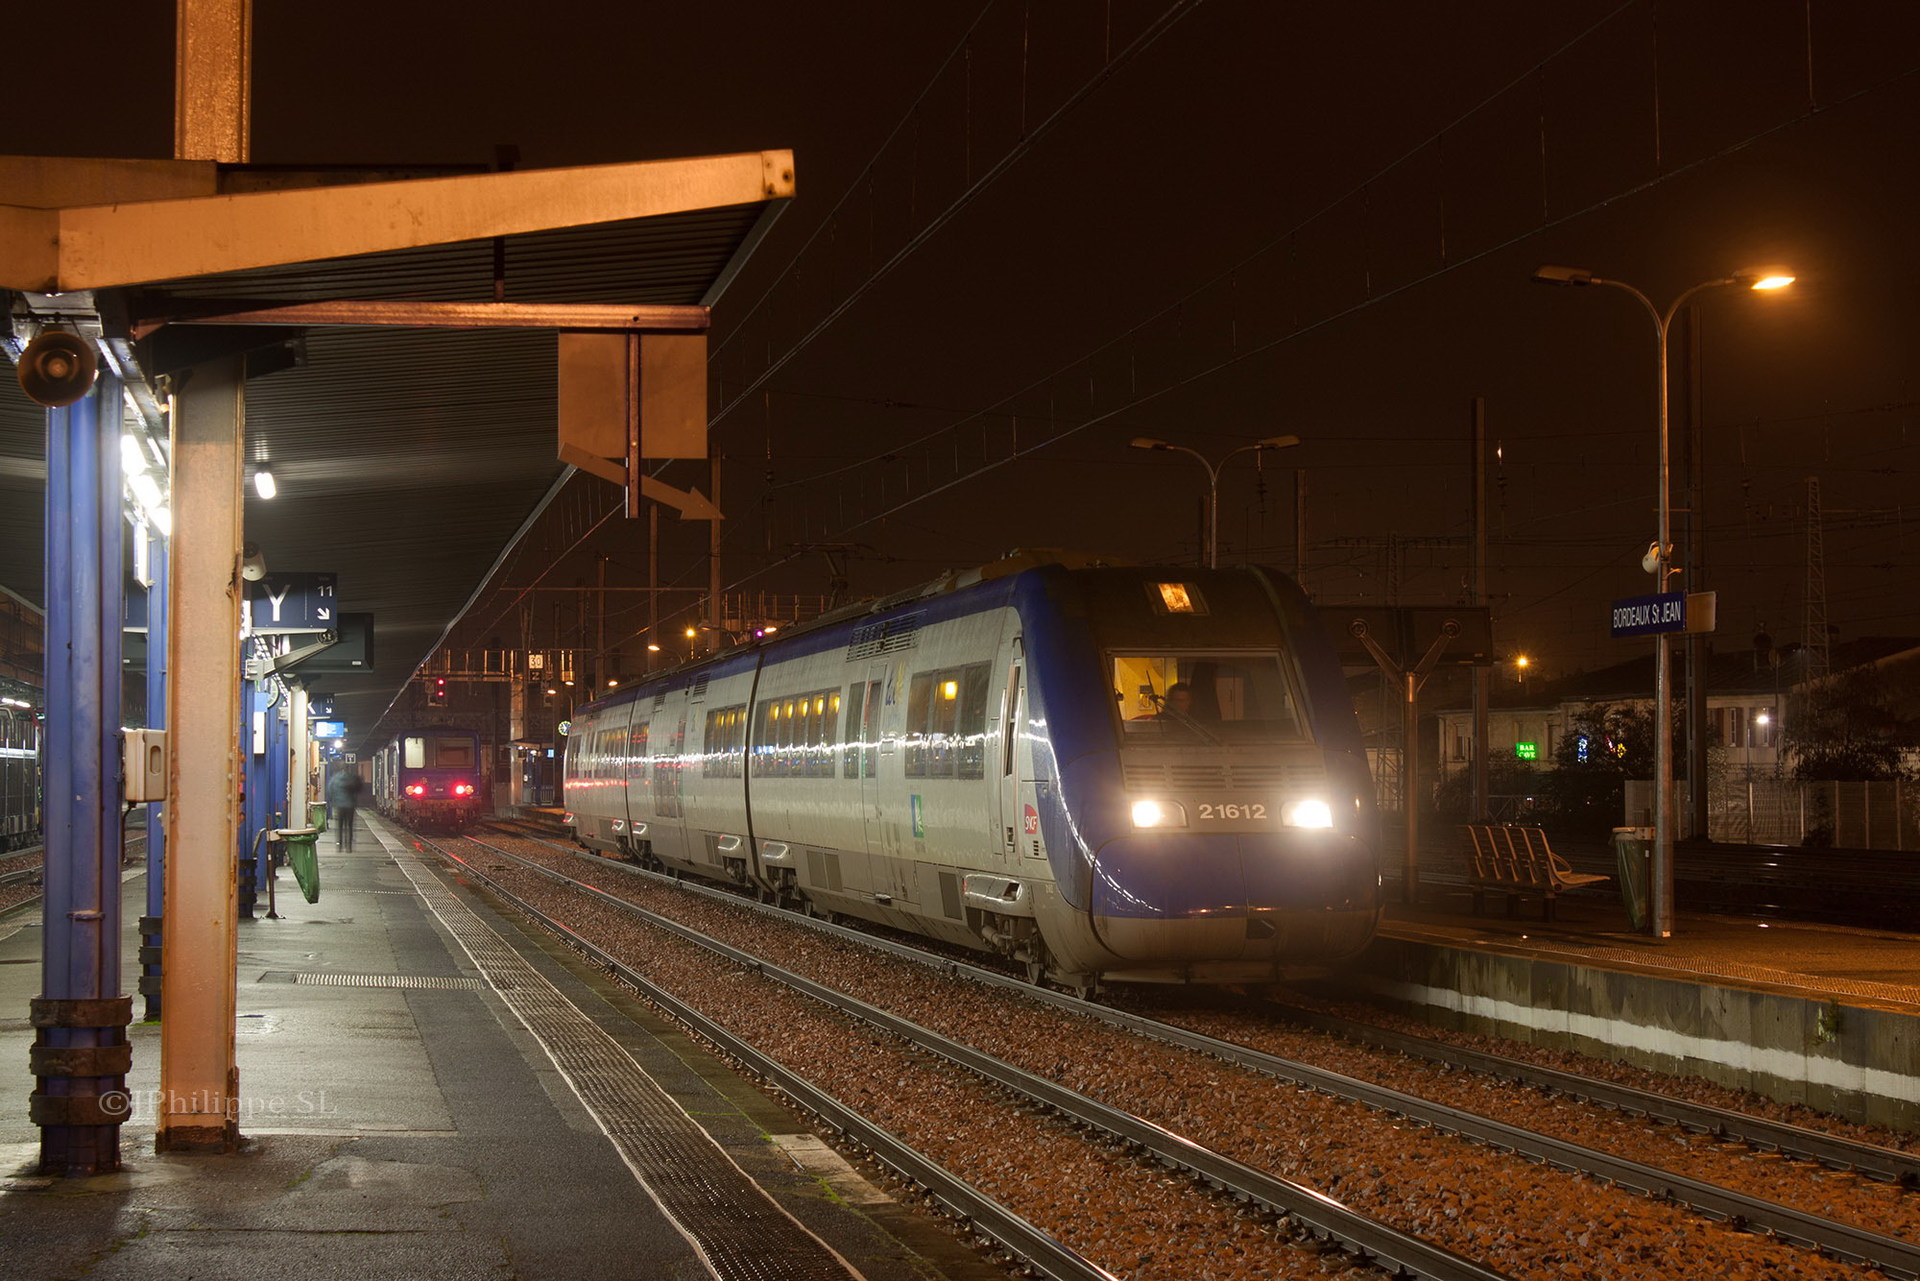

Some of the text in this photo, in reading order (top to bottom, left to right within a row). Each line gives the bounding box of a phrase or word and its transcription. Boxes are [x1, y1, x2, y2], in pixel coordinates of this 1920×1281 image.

[317, 585, 333, 597] 11
[262, 584, 291, 622] Y
[1613, 604, 1650, 629] BORDEAUX
[1661, 601, 1681, 623] JEAN
[530, 657, 542, 666] 30
[1198, 804, 1267, 820] 21612
